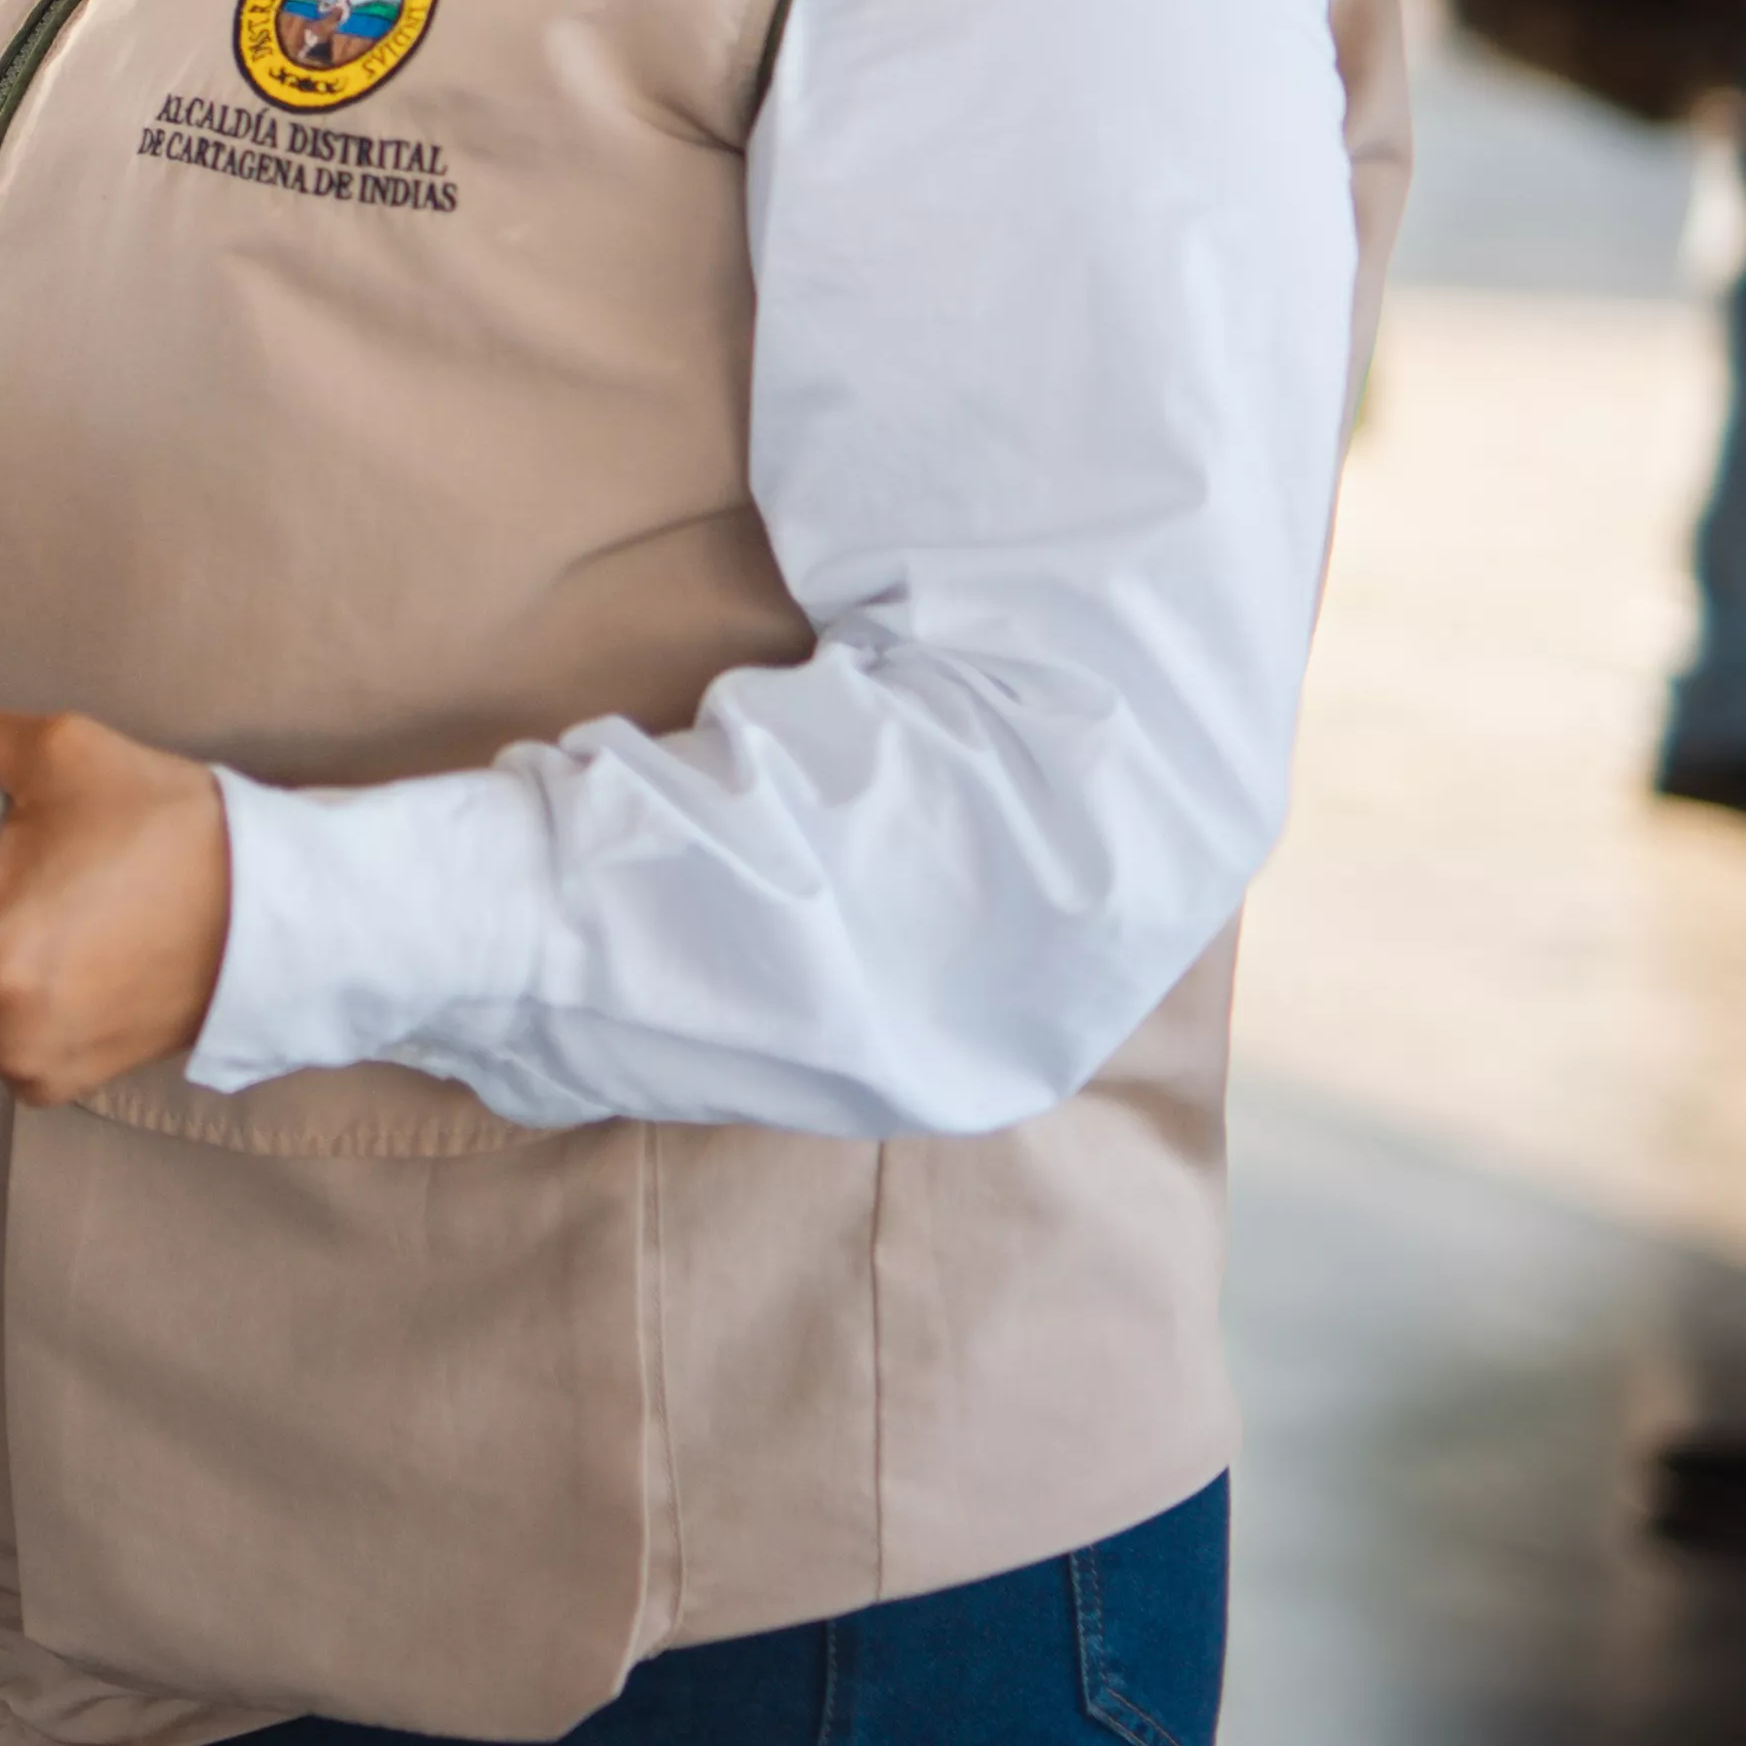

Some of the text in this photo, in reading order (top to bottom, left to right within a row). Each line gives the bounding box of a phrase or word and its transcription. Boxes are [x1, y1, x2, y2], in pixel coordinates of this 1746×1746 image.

[137, 128, 459, 213] DE CARTAGENA DE INDIAS
[156, 94, 448, 176] ALCALDÍA DISTRITAL
